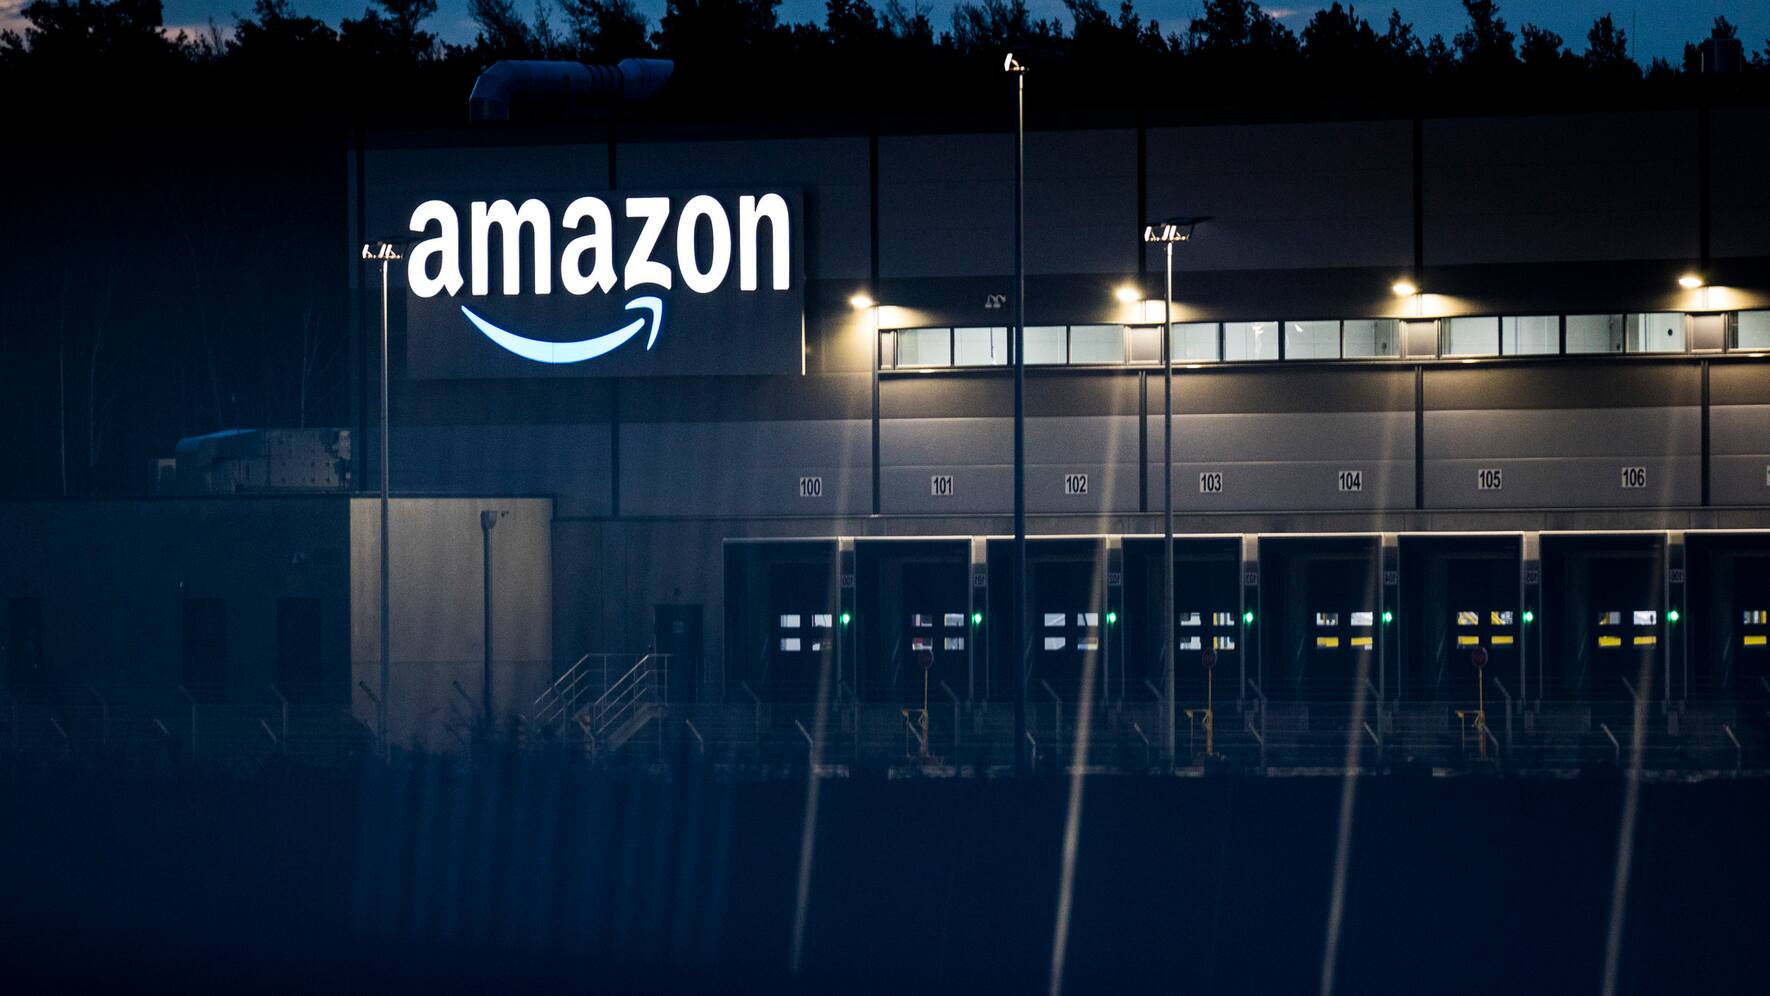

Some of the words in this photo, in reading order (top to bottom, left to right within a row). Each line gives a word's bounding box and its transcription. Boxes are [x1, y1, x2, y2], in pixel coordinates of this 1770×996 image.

[408, 192, 790, 298] amazon
[934, 477, 952, 494] 101
[1066, 475, 1087, 493] 102
[1201, 474, 1221, 491] 103
[1340, 472, 1361, 490] 104
[1479, 471, 1500, 488] 105
[1623, 468, 1645, 486] 106
[801, 478, 821, 495] 100
